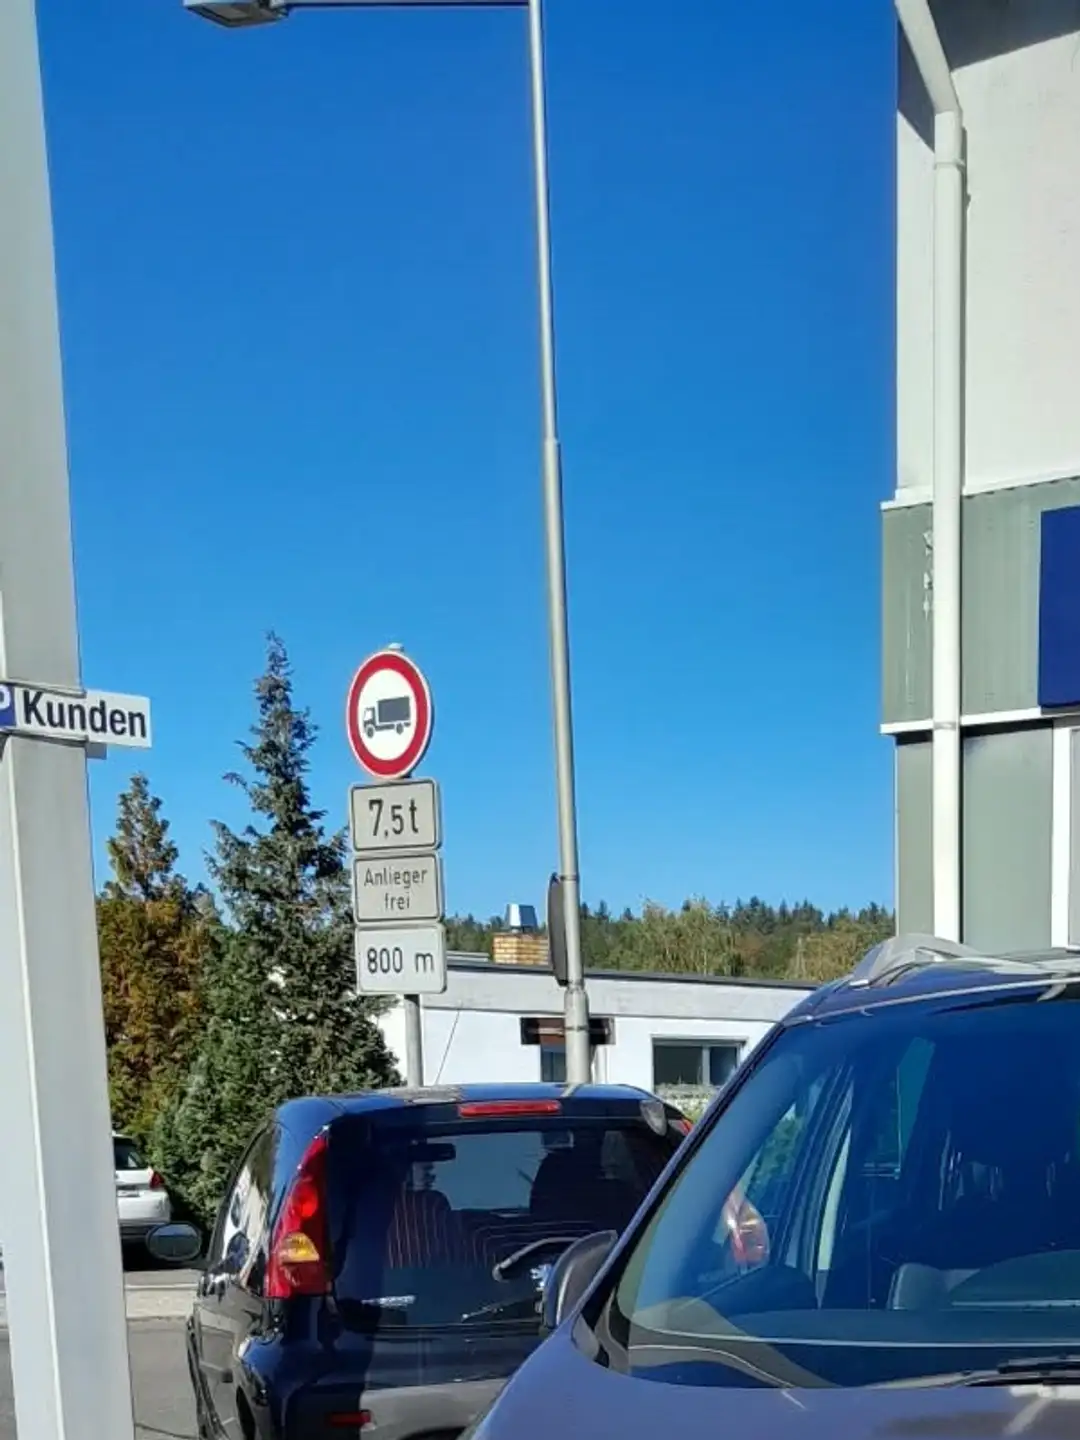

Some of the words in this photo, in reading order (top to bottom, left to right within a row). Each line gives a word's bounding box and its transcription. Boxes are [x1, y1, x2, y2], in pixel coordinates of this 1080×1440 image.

[23, 689, 147, 738] Kunden
[364, 867, 428, 889] Anlieger
[384, 891, 410, 911] frei
[367, 947, 403, 974] 800
[415, 951, 434, 974] m
